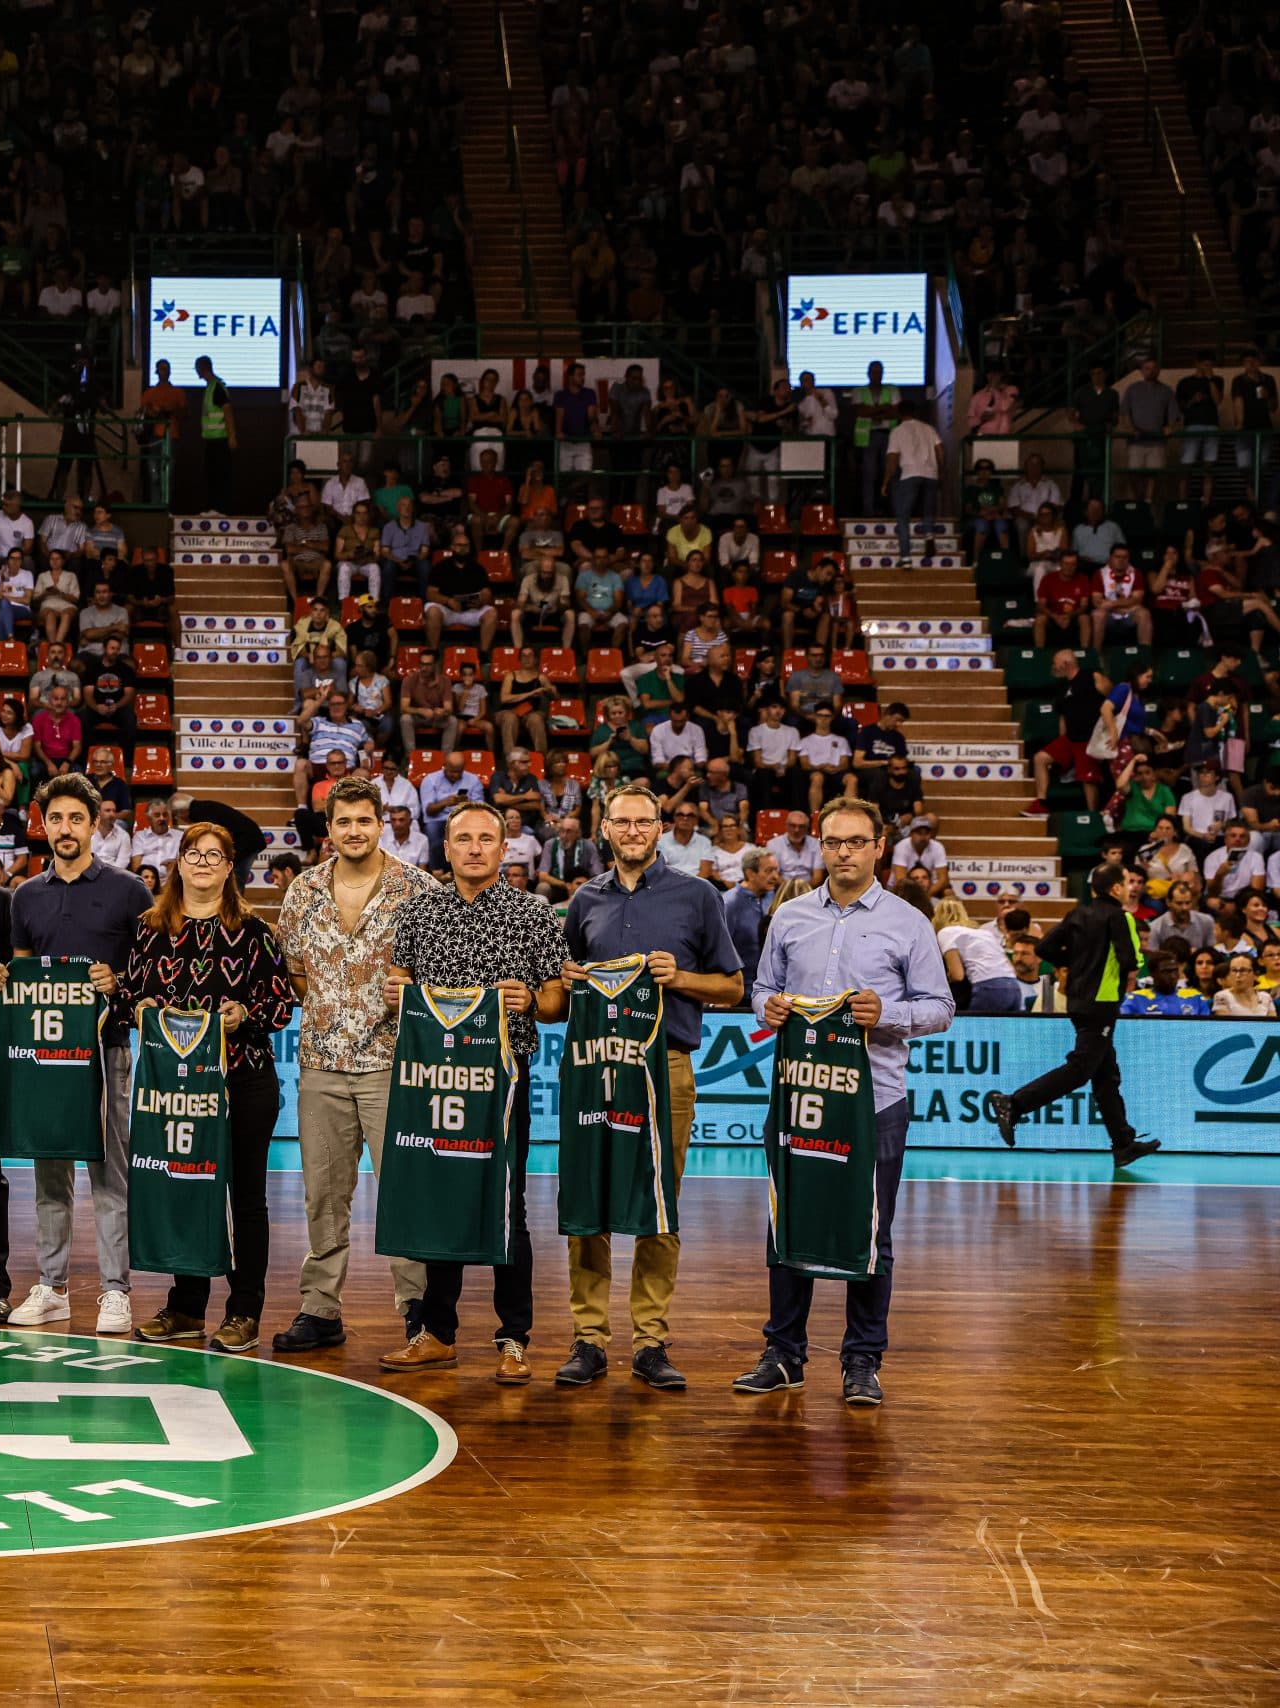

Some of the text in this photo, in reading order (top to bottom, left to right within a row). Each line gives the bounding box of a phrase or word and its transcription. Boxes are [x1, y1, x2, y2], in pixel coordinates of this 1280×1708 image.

[194, 315, 278, 336] EFFIA
[833, 312, 924, 334] EFFIA
[181, 538, 270, 549] Ville de Limoges
[185, 634, 210, 644] Ville
[232, 635, 279, 646] Limoges
[878, 639, 905, 650] Ville
[189, 737, 290, 750] Ville de Limoges
[936, 746, 951, 756] de
[956, 746, 1011, 758] Limoges
[968, 861, 983, 872] de
[989, 862, 1047, 875] Limoges
[2, 981, 96, 1006] LIMOGES
[31, 1009, 64, 1042] 16
[906, 1040, 1000, 1075] CELUI
[399, 1060, 495, 1092] LIMOGES
[136, 1087, 220, 1118] LIMOGES
[428, 1094, 466, 1131] 16
[789, 1091, 825, 1130] 16
[908, 1089, 950, 1123] LA
[164, 1120, 195, 1154] 16
